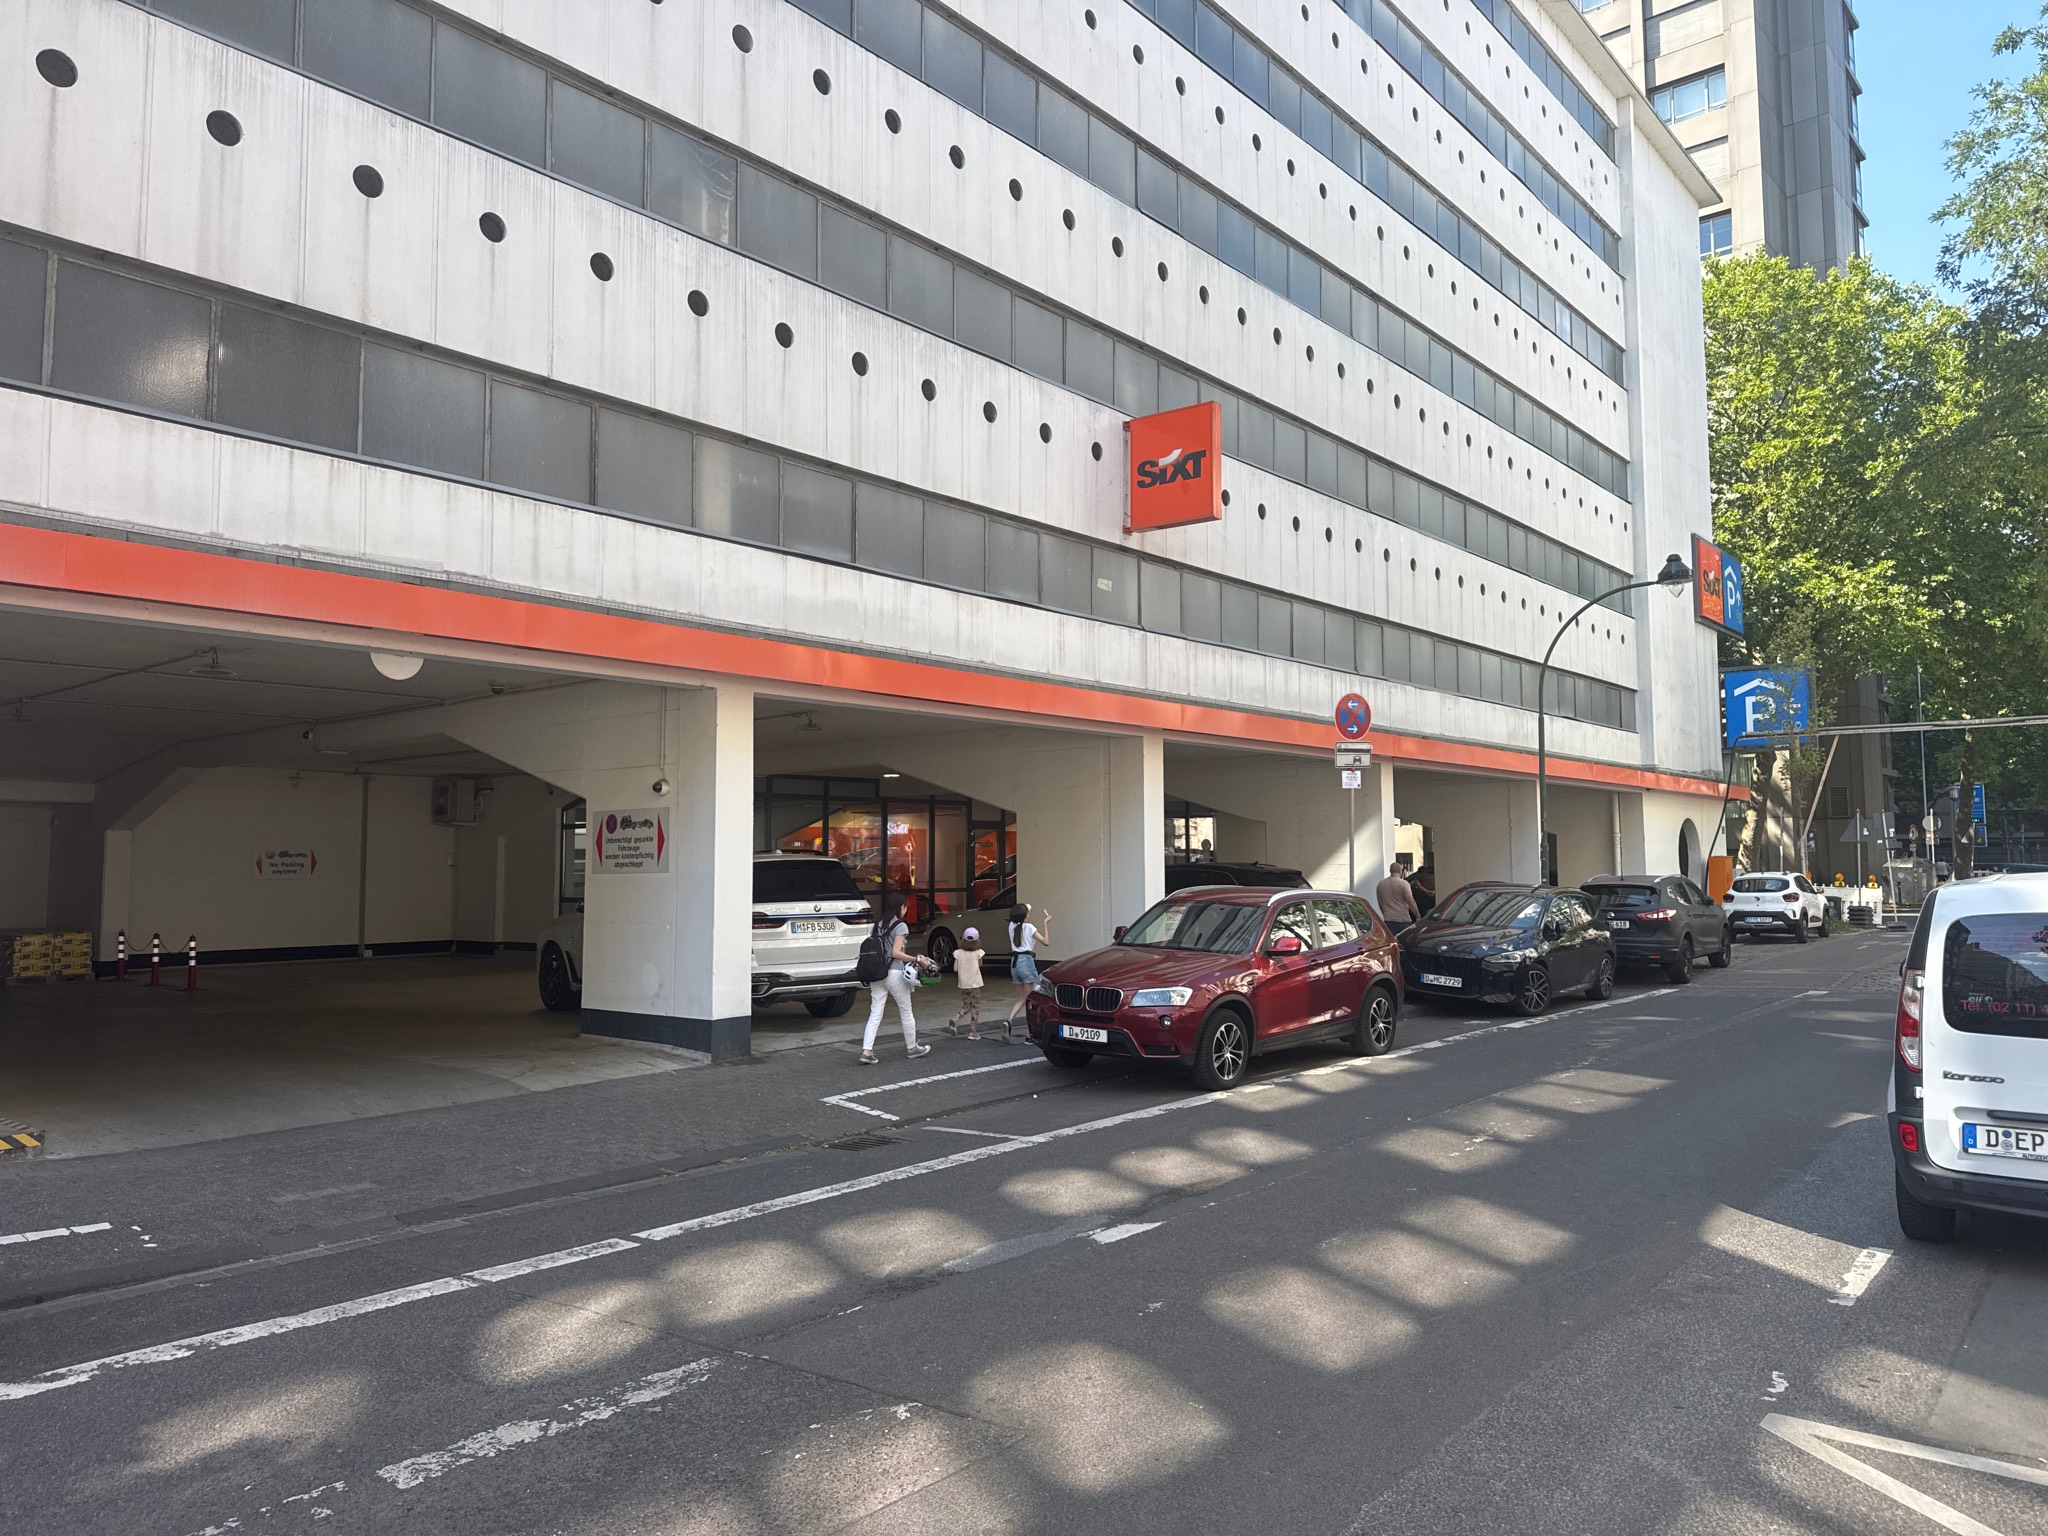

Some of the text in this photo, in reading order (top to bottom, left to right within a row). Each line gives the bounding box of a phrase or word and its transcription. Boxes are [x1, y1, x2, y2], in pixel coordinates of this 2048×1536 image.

[1745, 695, 1776, 733] P
[618, 844, 640, 853] Fahrzeuge
[621, 851, 655, 860] kostenpflichtig
[281, 861, 305, 869] Parking
[614, 860, 644, 869] abgeschleppt
[817, 922, 836, 931] 5308
[1443, 977, 1461, 986] 2729
[1069, 1026, 1101, 1041] D 9109
[1942, 1069, 2006, 1085] Kangoo
[1985, 1128, 2045, 1152] D EP
